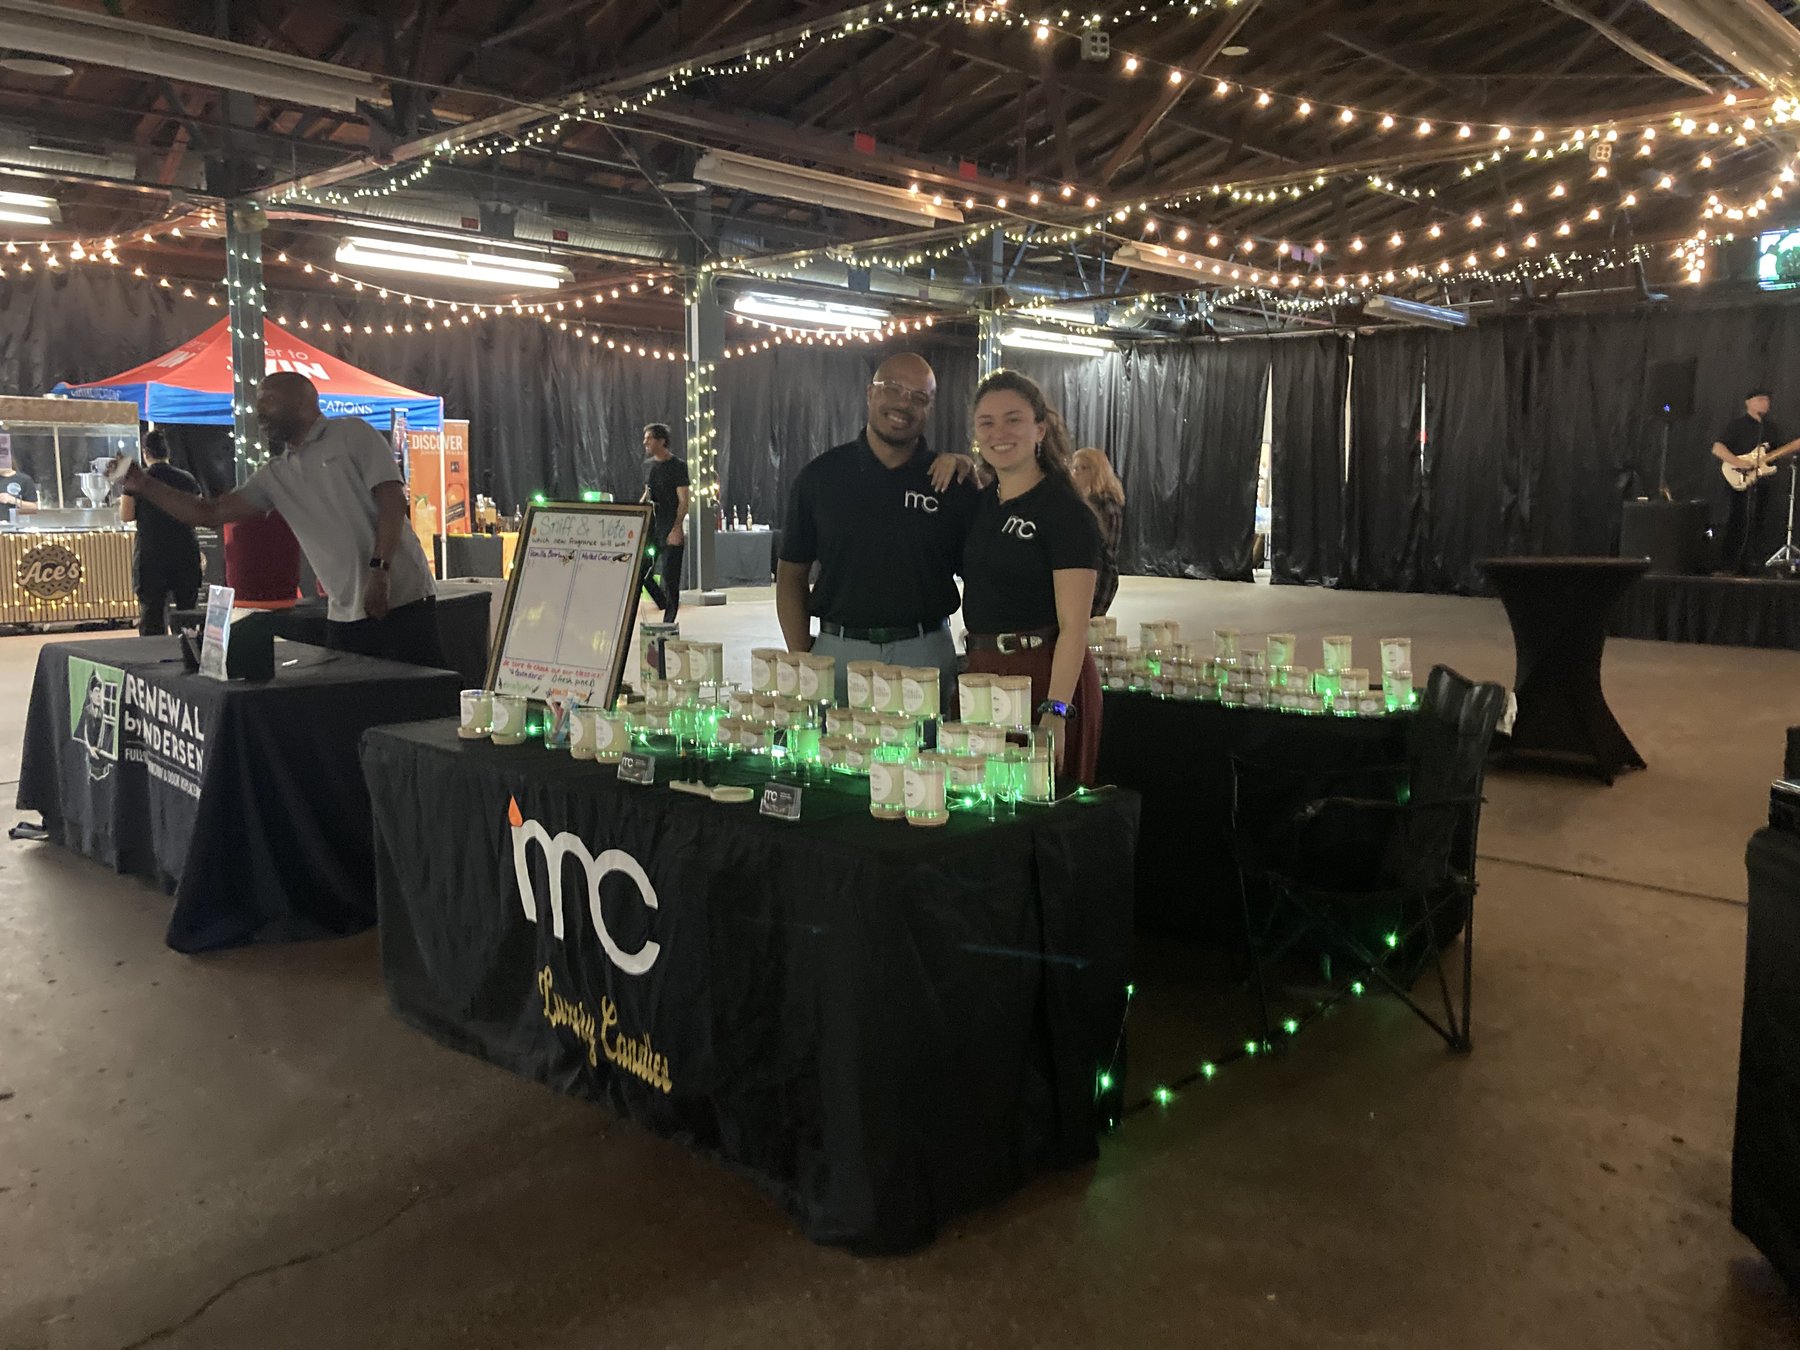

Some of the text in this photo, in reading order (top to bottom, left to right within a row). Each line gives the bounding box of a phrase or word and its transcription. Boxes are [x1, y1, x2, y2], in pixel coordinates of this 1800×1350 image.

[287, 349, 309, 361] to
[18, 561, 80, 586] Ace's
[125, 673, 204, 741] RENEWAL
[143, 717, 204, 774] NDERSEN
[601, 995, 672, 1094] Candles
